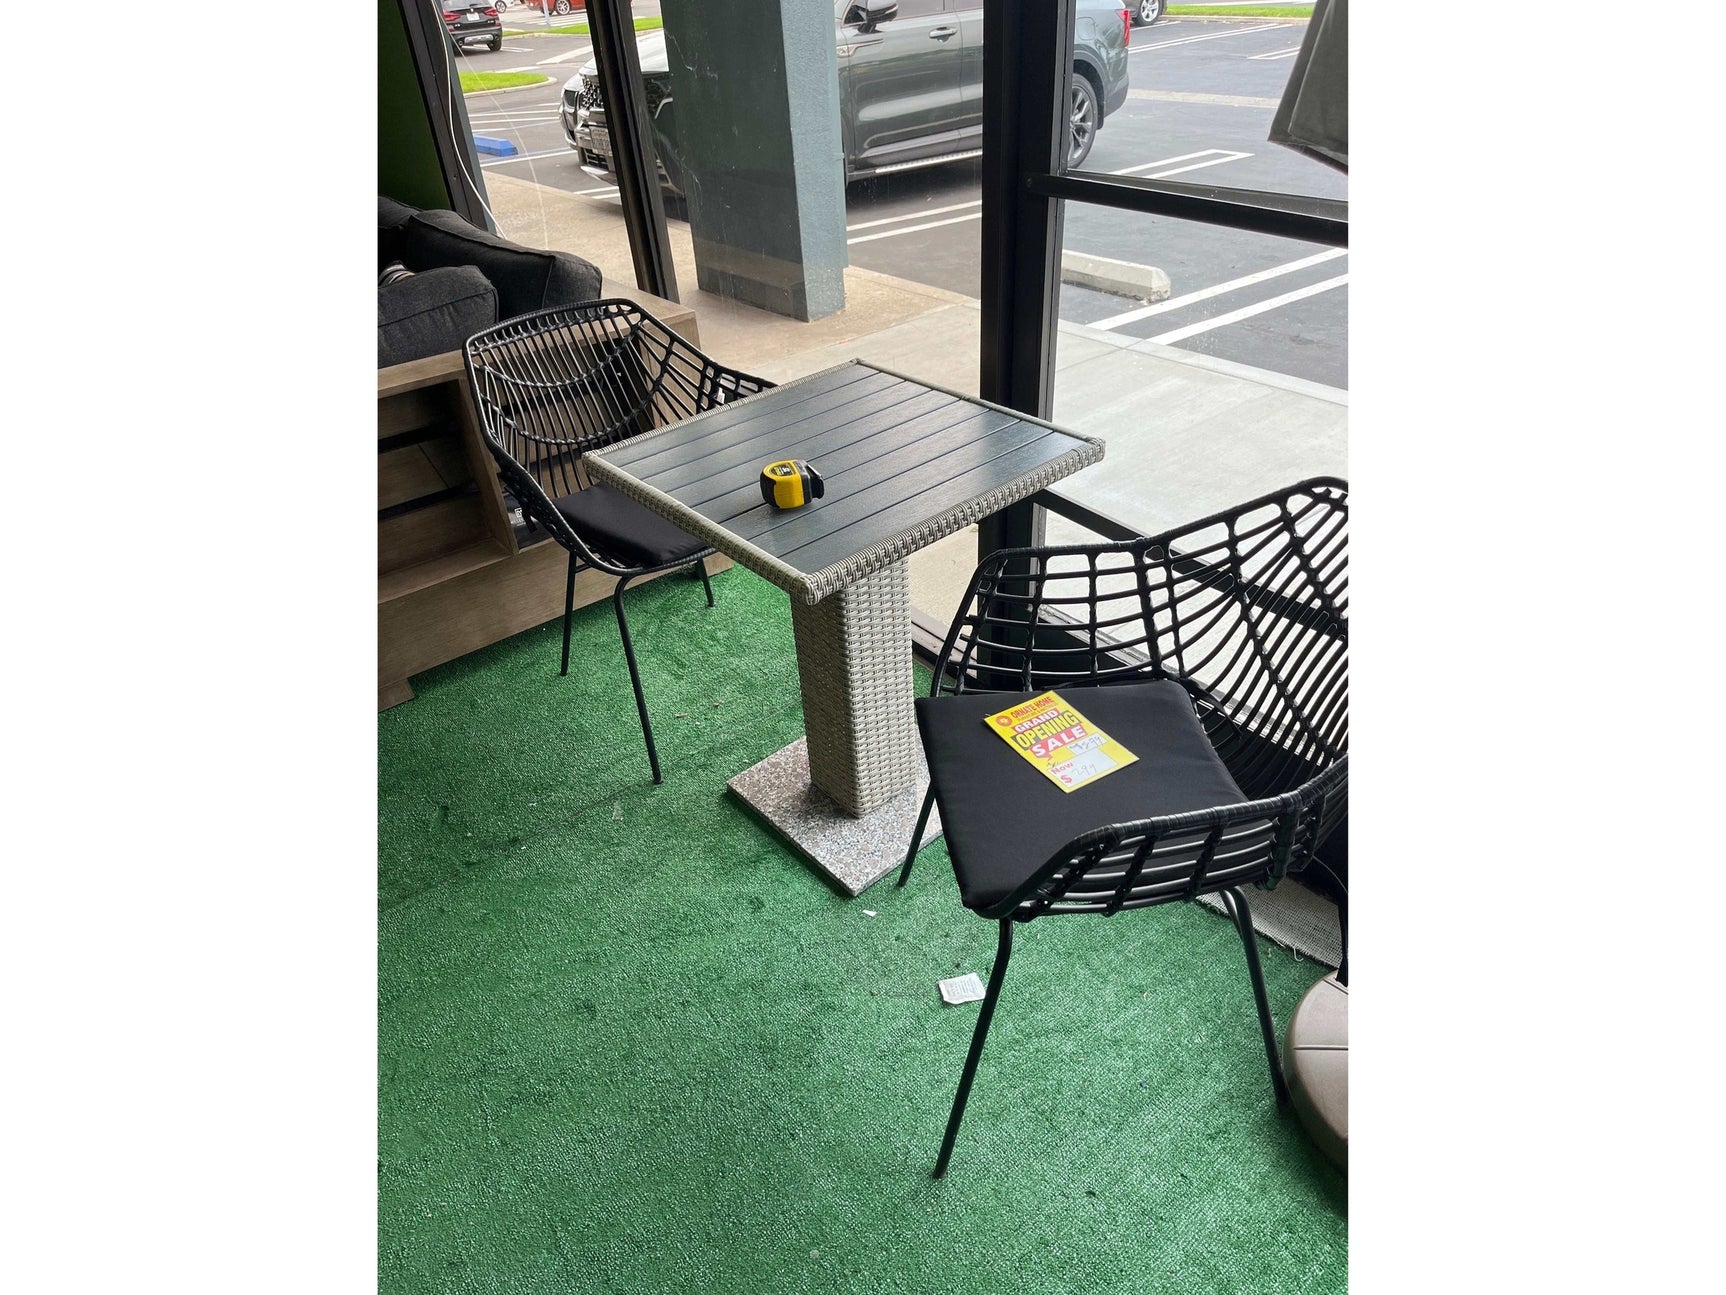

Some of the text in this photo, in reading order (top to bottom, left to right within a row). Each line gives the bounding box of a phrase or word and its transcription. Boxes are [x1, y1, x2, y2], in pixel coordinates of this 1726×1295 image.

[1034, 696, 1055, 709] HOME
[1014, 709, 1059, 733] GRAND
[1015, 711, 1080, 749] OPENING
[1031, 725, 1086, 757] SALE
